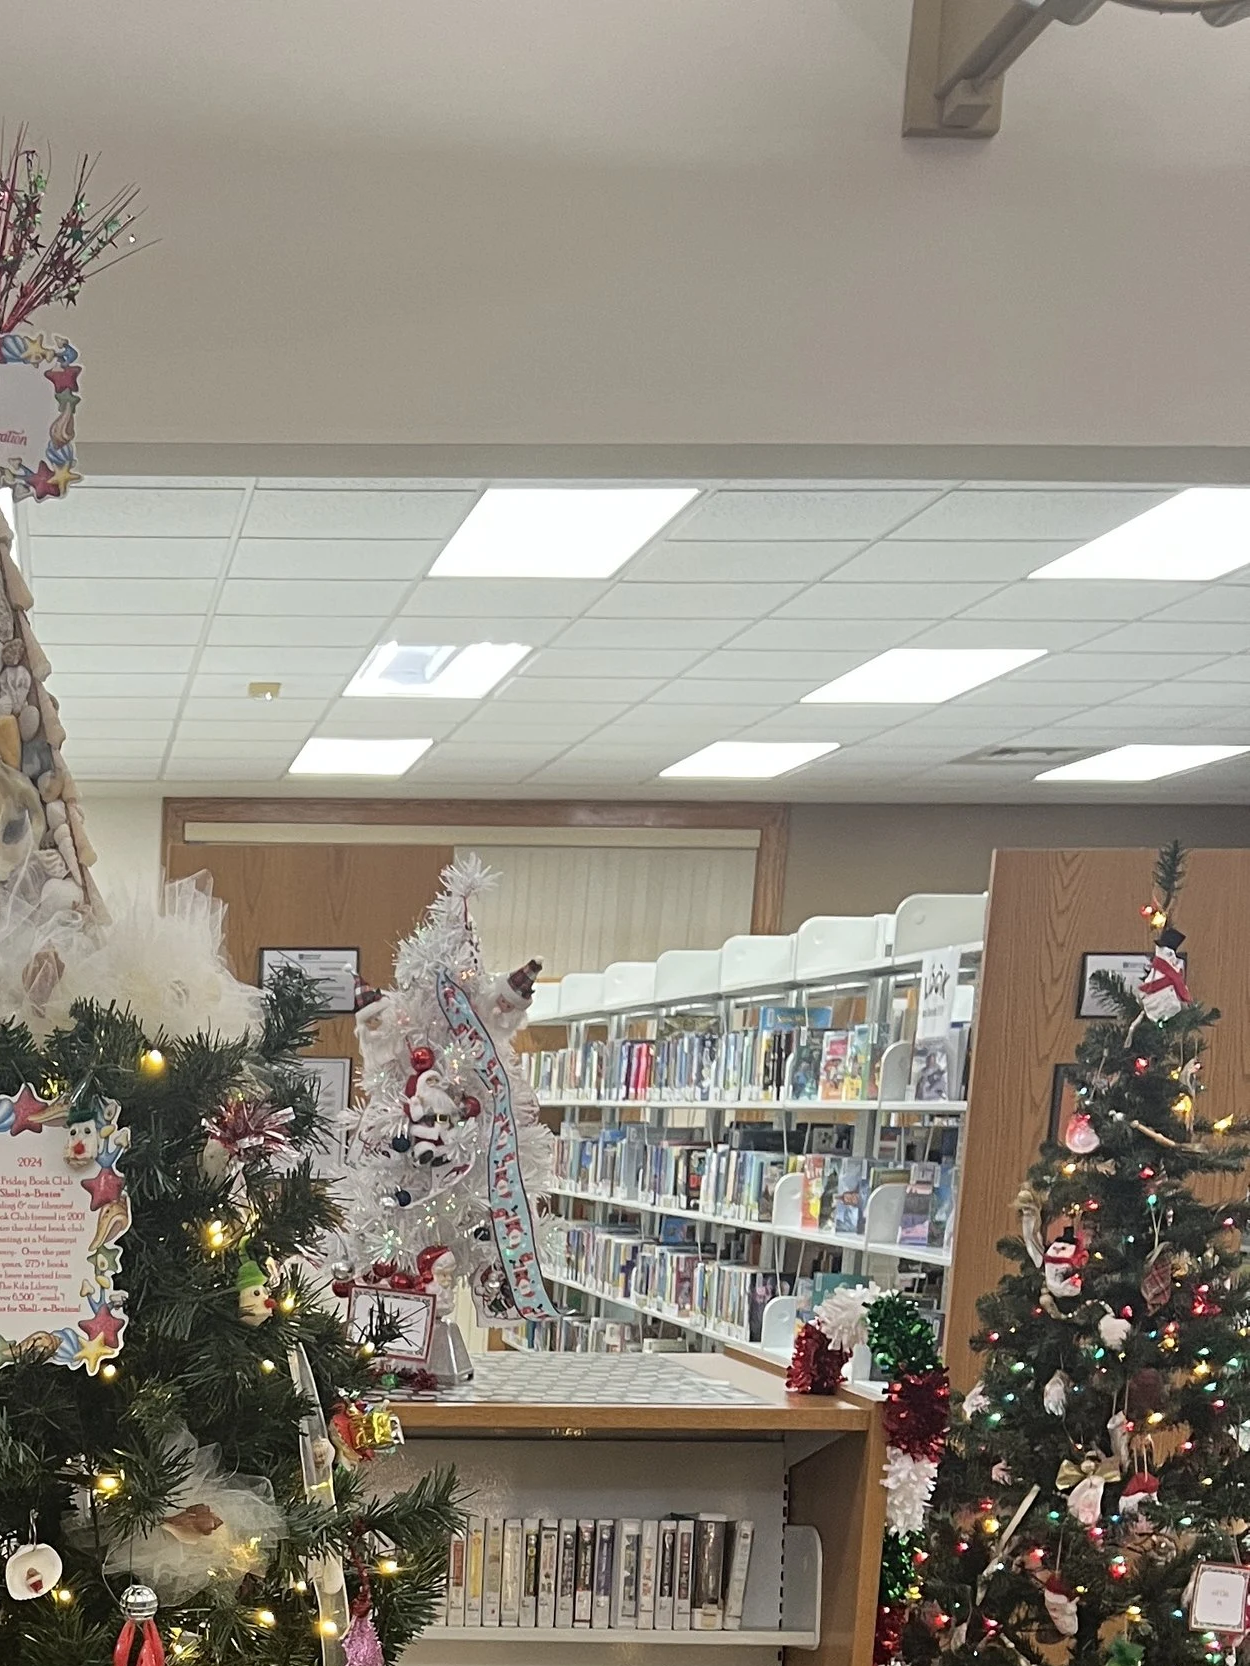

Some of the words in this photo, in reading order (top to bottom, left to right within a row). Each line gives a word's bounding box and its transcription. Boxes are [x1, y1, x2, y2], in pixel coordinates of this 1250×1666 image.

[17, 1157, 42, 1167] 2024
[1, 1176, 27, 1187] Friday
[30, 1176, 50, 1185] Book
[52, 1176, 74, 1186] Club
[10, 1212, 30, 1220] Club
